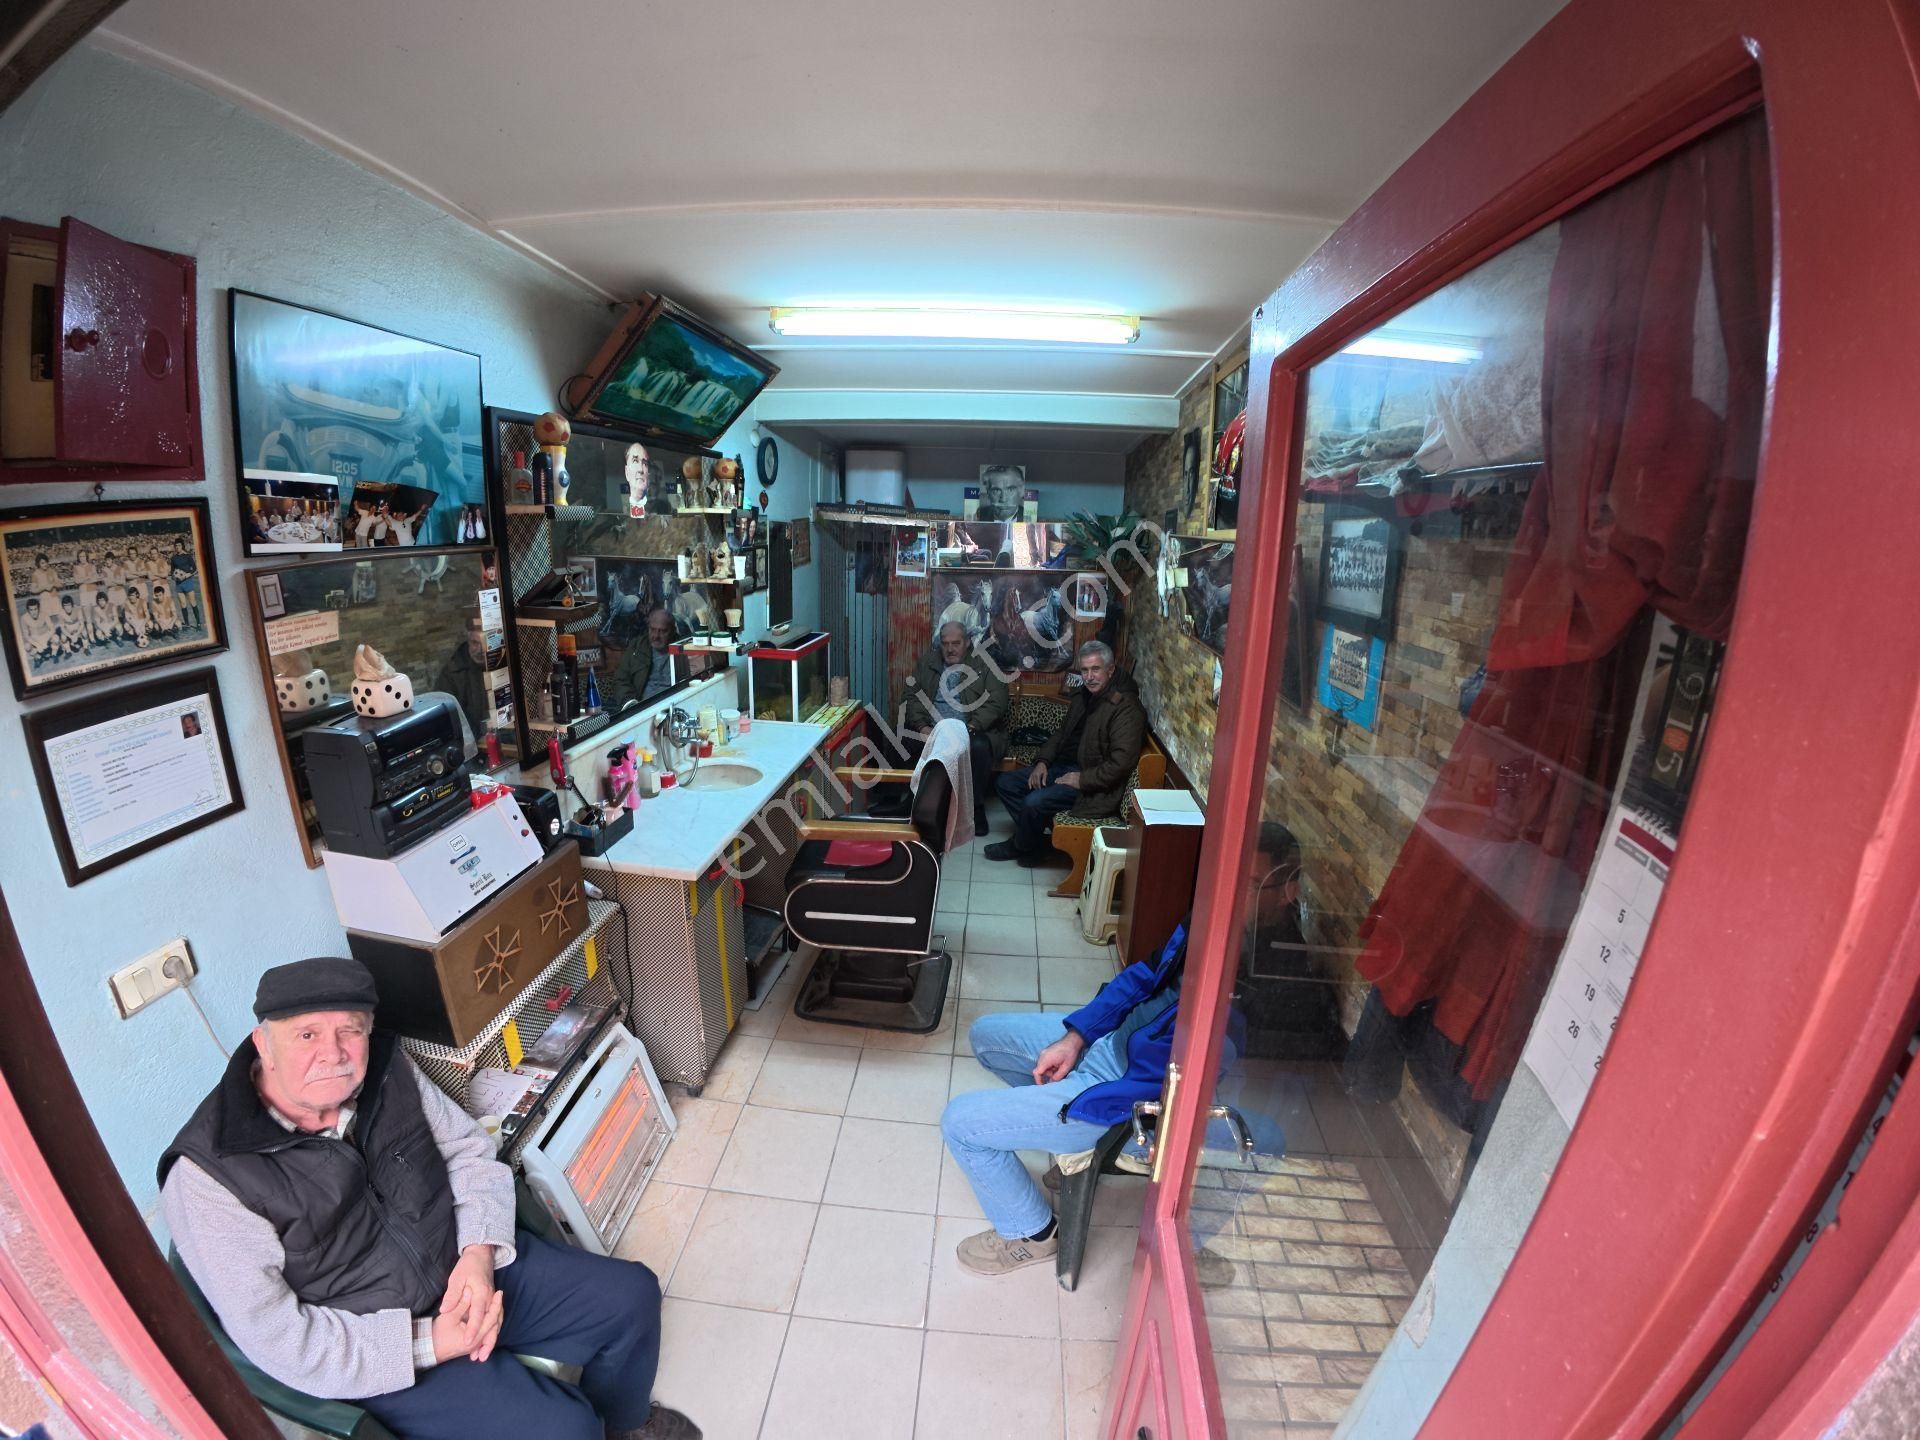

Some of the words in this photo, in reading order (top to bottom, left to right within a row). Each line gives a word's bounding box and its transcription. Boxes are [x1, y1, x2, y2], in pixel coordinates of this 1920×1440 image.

[331, 459, 359, 476] 1205
[1617, 908, 1626, 924] 5
[1599, 944, 1612, 964] 12
[1584, 983, 1596, 1002] 19
[1567, 1019, 1581, 1039] 26
[1806, 1222, 1819, 1244] 8
